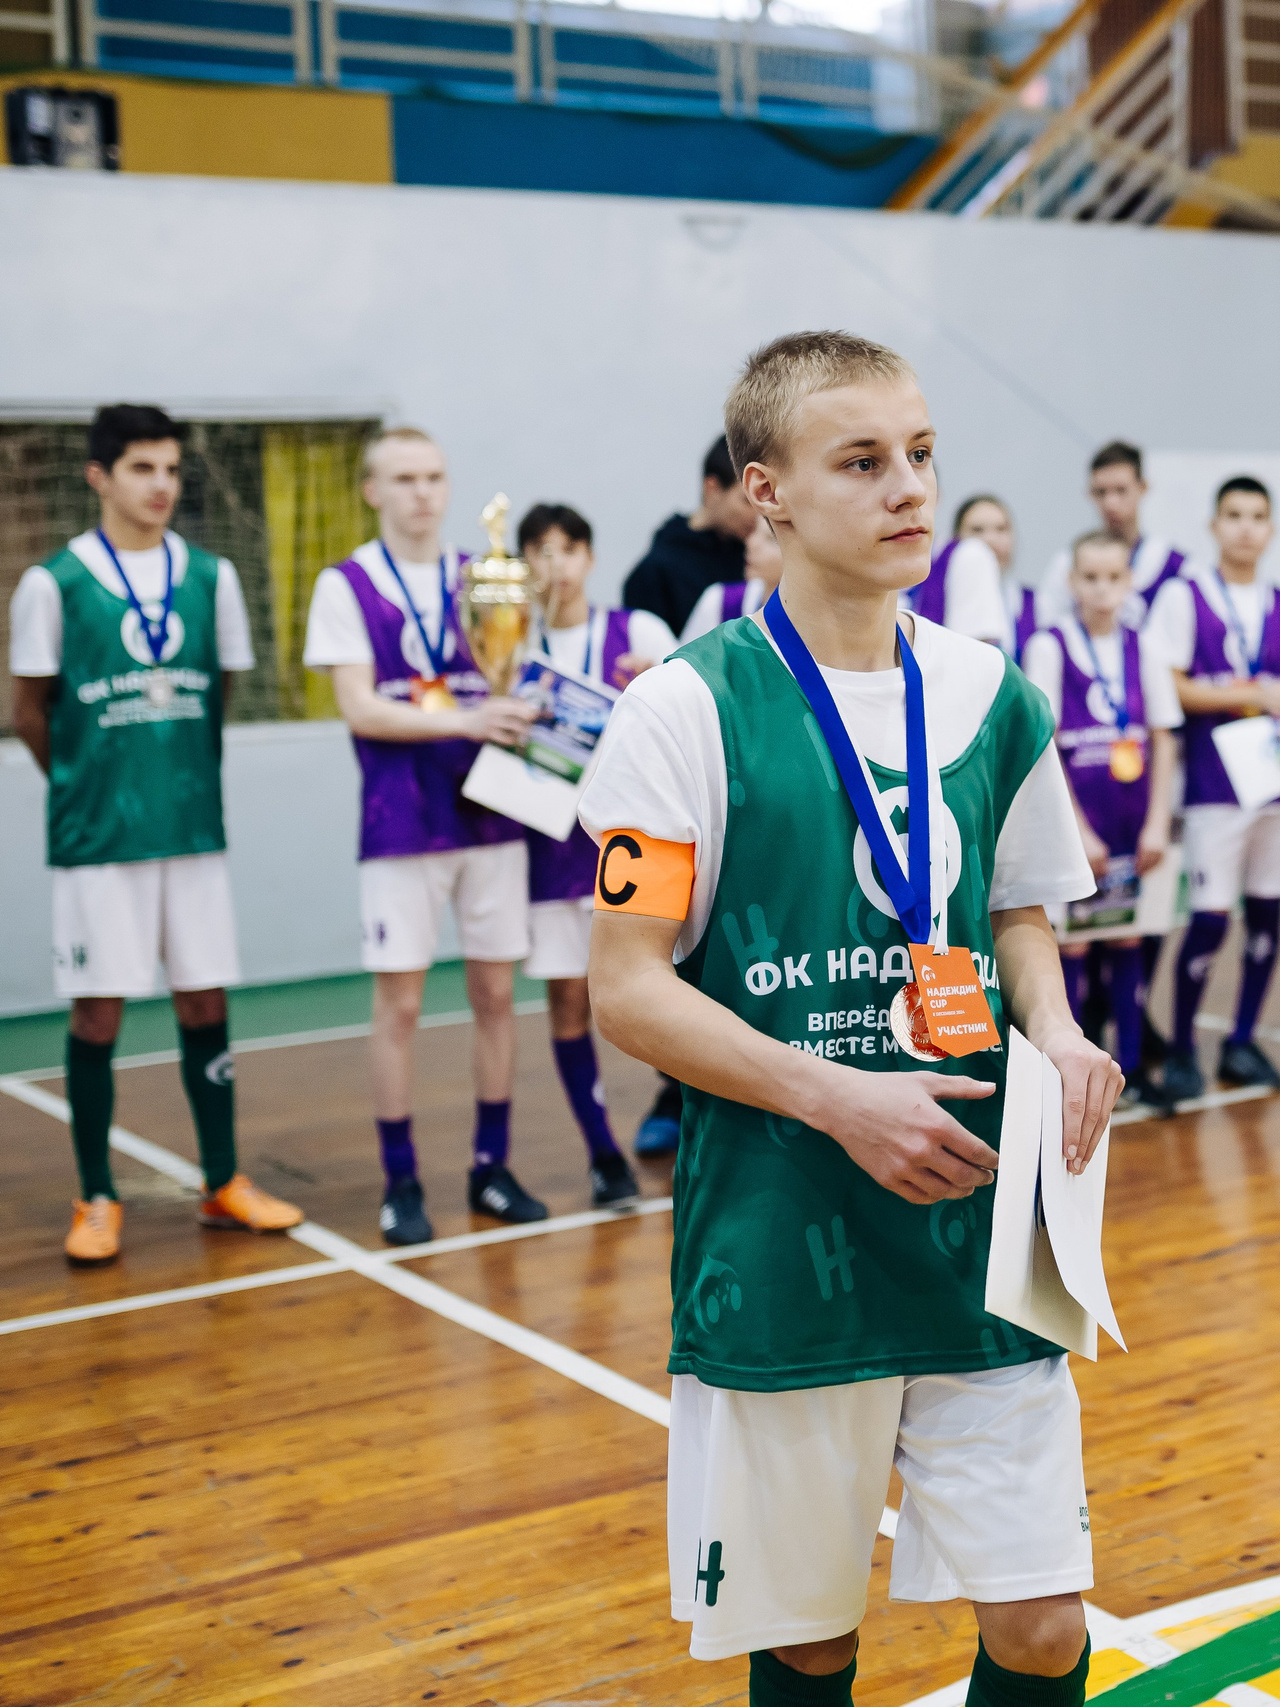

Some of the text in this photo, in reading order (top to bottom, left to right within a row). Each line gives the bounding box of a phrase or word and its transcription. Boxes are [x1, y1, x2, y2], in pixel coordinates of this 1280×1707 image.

[599, 834, 643, 906] C
[745, 953, 814, 996] ФК
[926, 984, 978, 997] НАДЕЖДИК
[930, 999, 947, 1009] CUP
[807, 1004, 891, 1032] ВПЕРЁД
[937, 1022, 989, 1037] УЧАСТНИК
